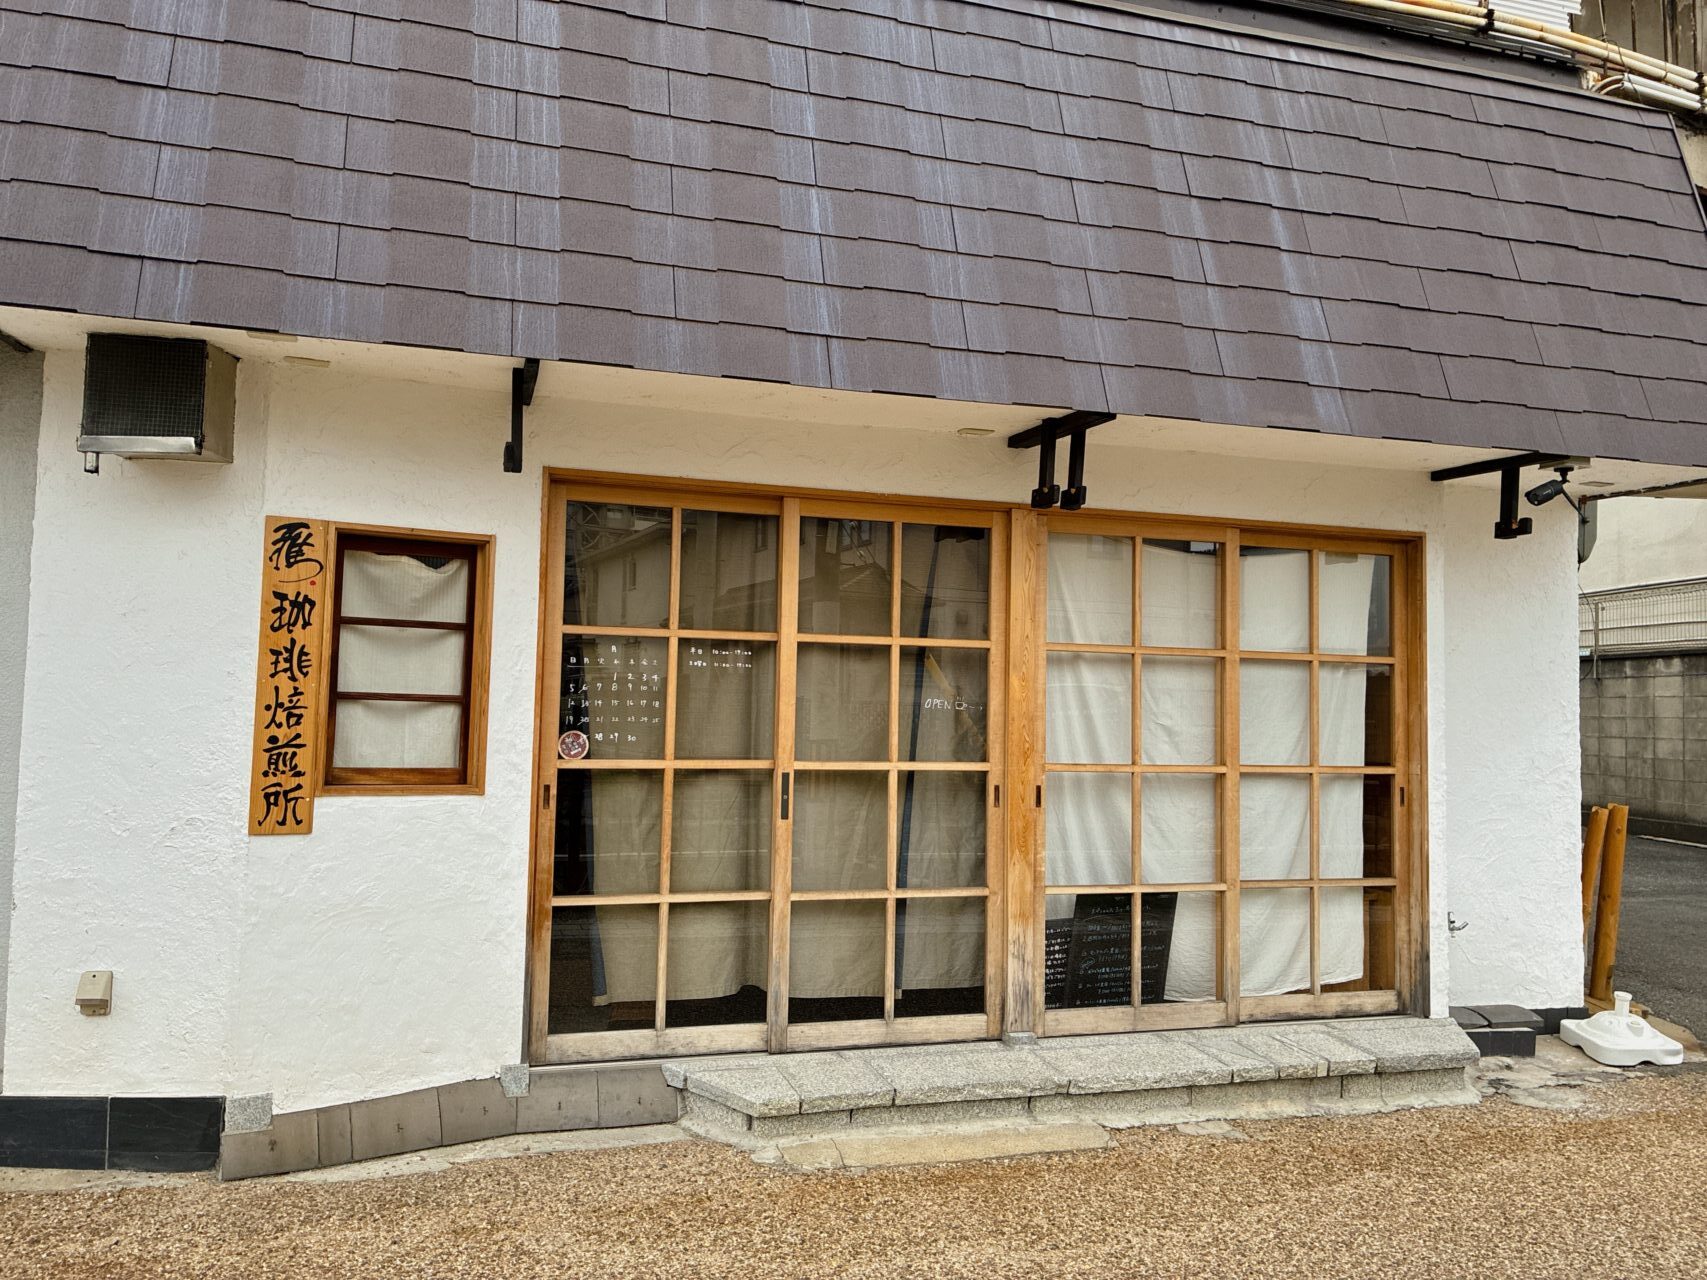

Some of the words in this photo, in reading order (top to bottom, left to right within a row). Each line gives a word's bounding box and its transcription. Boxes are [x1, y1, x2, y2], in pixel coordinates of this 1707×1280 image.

[642, 673, 647, 681] 3
[651, 674, 659, 682] 4
[569, 683, 576, 693] 5
[596, 682, 602, 691] 7
[611, 682, 618, 691] 8
[627, 683, 633, 692] 9
[567, 698, 576, 709] 12
[594, 699, 603, 708] 14
[611, 699, 620, 707] 15
[626, 699, 634, 707] 16
[640, 699, 647, 708] 17
[652, 700, 660, 708] 18
[924, 698, 951, 710] OPEN
[565, 715, 574, 726] 19
[594, 732, 604, 741] 28
[609, 732, 619, 743] 29
[627, 734, 637, 742] 30
